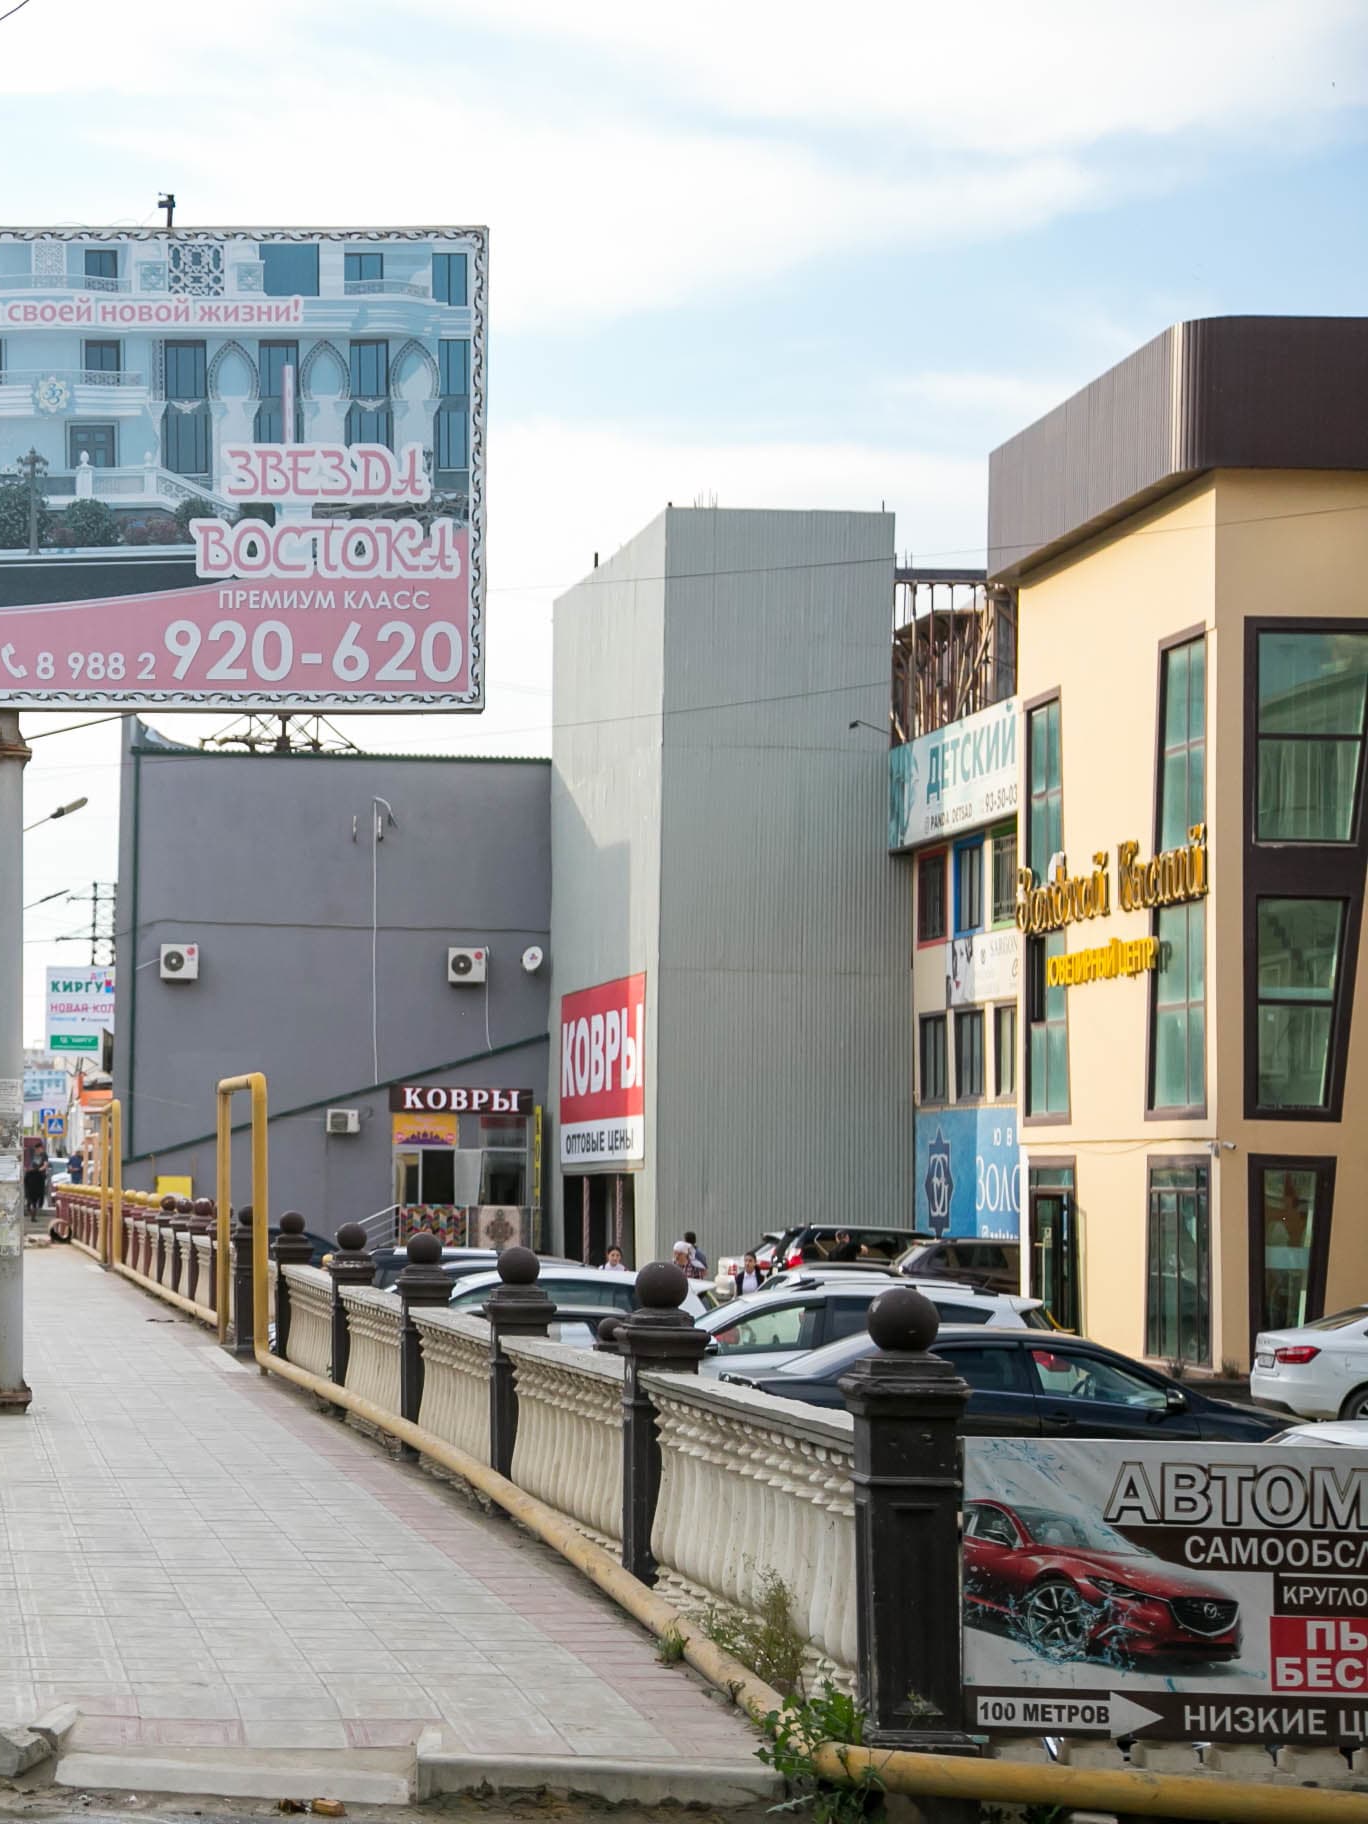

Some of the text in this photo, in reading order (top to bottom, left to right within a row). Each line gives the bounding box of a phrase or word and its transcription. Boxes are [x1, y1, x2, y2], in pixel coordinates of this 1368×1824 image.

[8, 297, 92, 323] своей
[101, 297, 190, 323] новой
[199, 299, 300, 323] жизни!
[196, 523, 454, 572] ВОСТОКА
[218, 590, 431, 610] ПРЕМИУМ КЛАСС
[36, 619, 463, 683] 8 988 2 920-620
[926, 702, 1016, 805] ДЕТСКИЙ
[1118, 822, 1210, 913] Каспий
[1047, 937, 1119, 987] ЮВЕЛИРНЫЙ
[1118, 936, 1159, 980] ЦЕНТР
[51, 980, 104, 993] КИРГУ
[561, 1003, 644, 1098] КОВРЫ
[403, 1087, 520, 1112] КОВРЫ
[566, 1127, 634, 1155] ОПТОВЫЕ ЦЕНЫ
[1275, 1656, 1368, 1689] БЕС
[979, 1702, 1110, 1725] 100 МЕТРОВ
[1184, 1705, 1328, 1736] НИЗКИЕ
